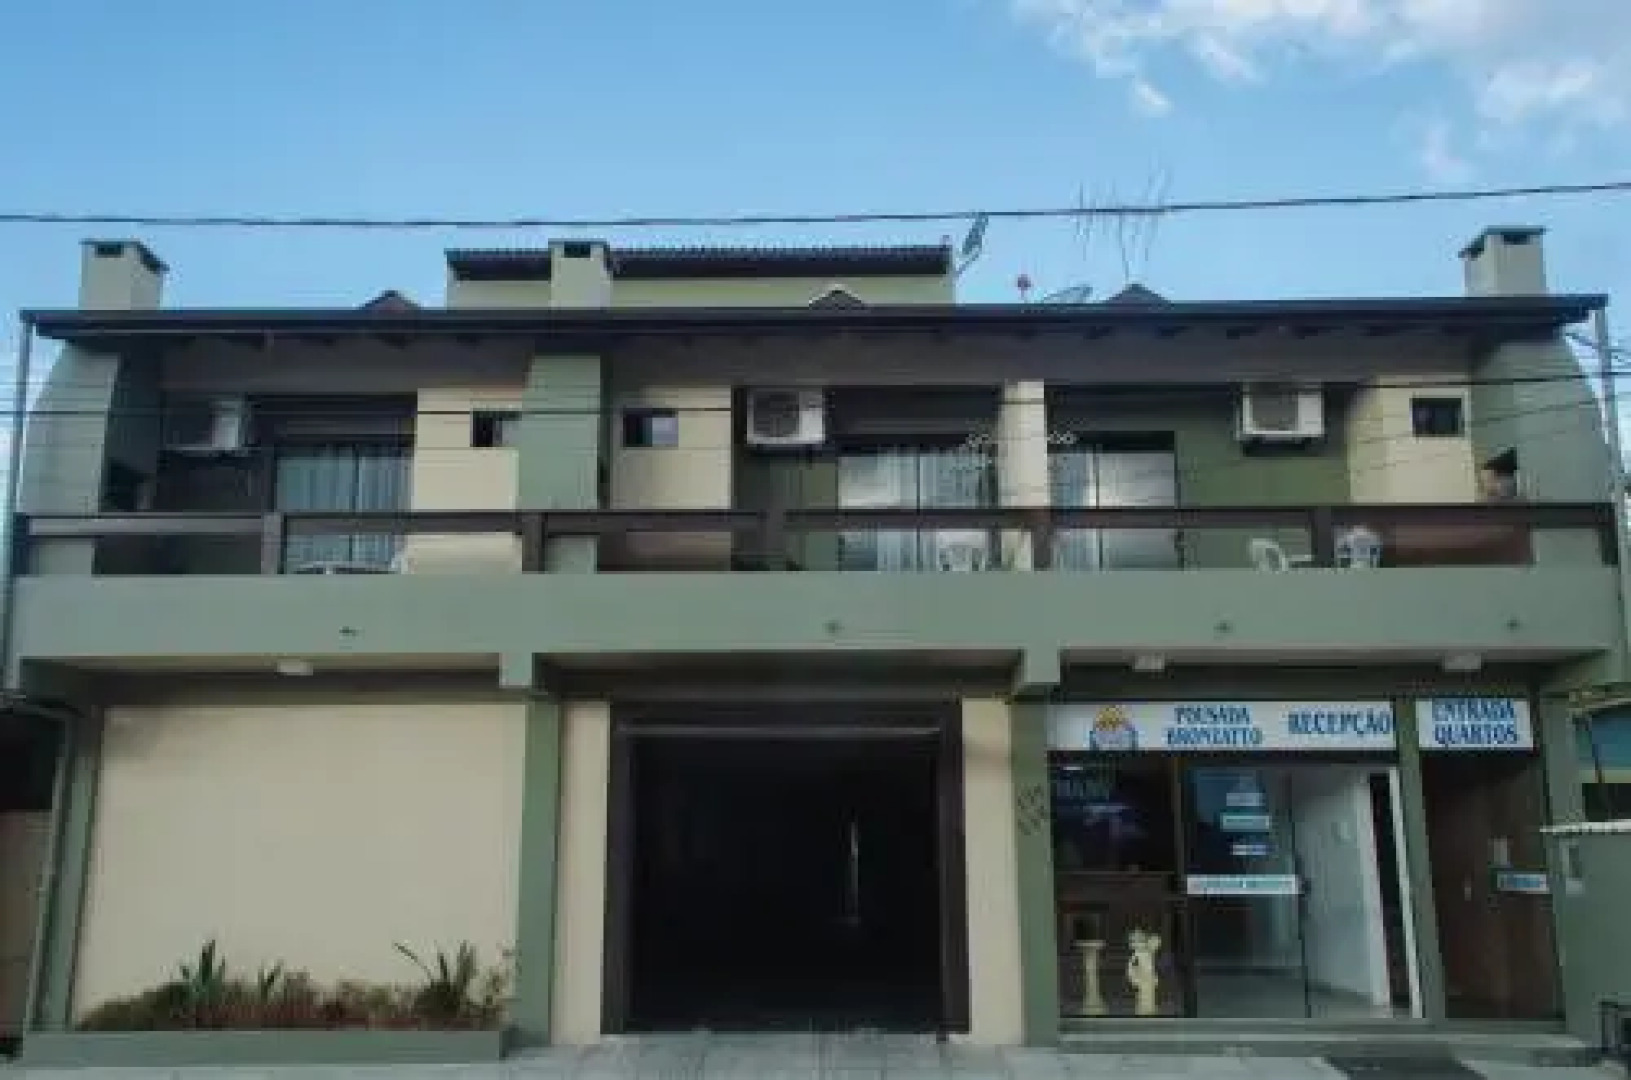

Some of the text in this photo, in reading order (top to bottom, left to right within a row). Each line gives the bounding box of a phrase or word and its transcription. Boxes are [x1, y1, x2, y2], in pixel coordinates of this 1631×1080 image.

[1174, 706, 1251, 725] POUSADA
[1432, 699, 1515, 722] ENTRADA
[1287, 708, 1392, 736] RECEPÇÃO
[1166, 726, 1263, 745] BRONZATTO
[1434, 724, 1518, 746] QUARTOS
